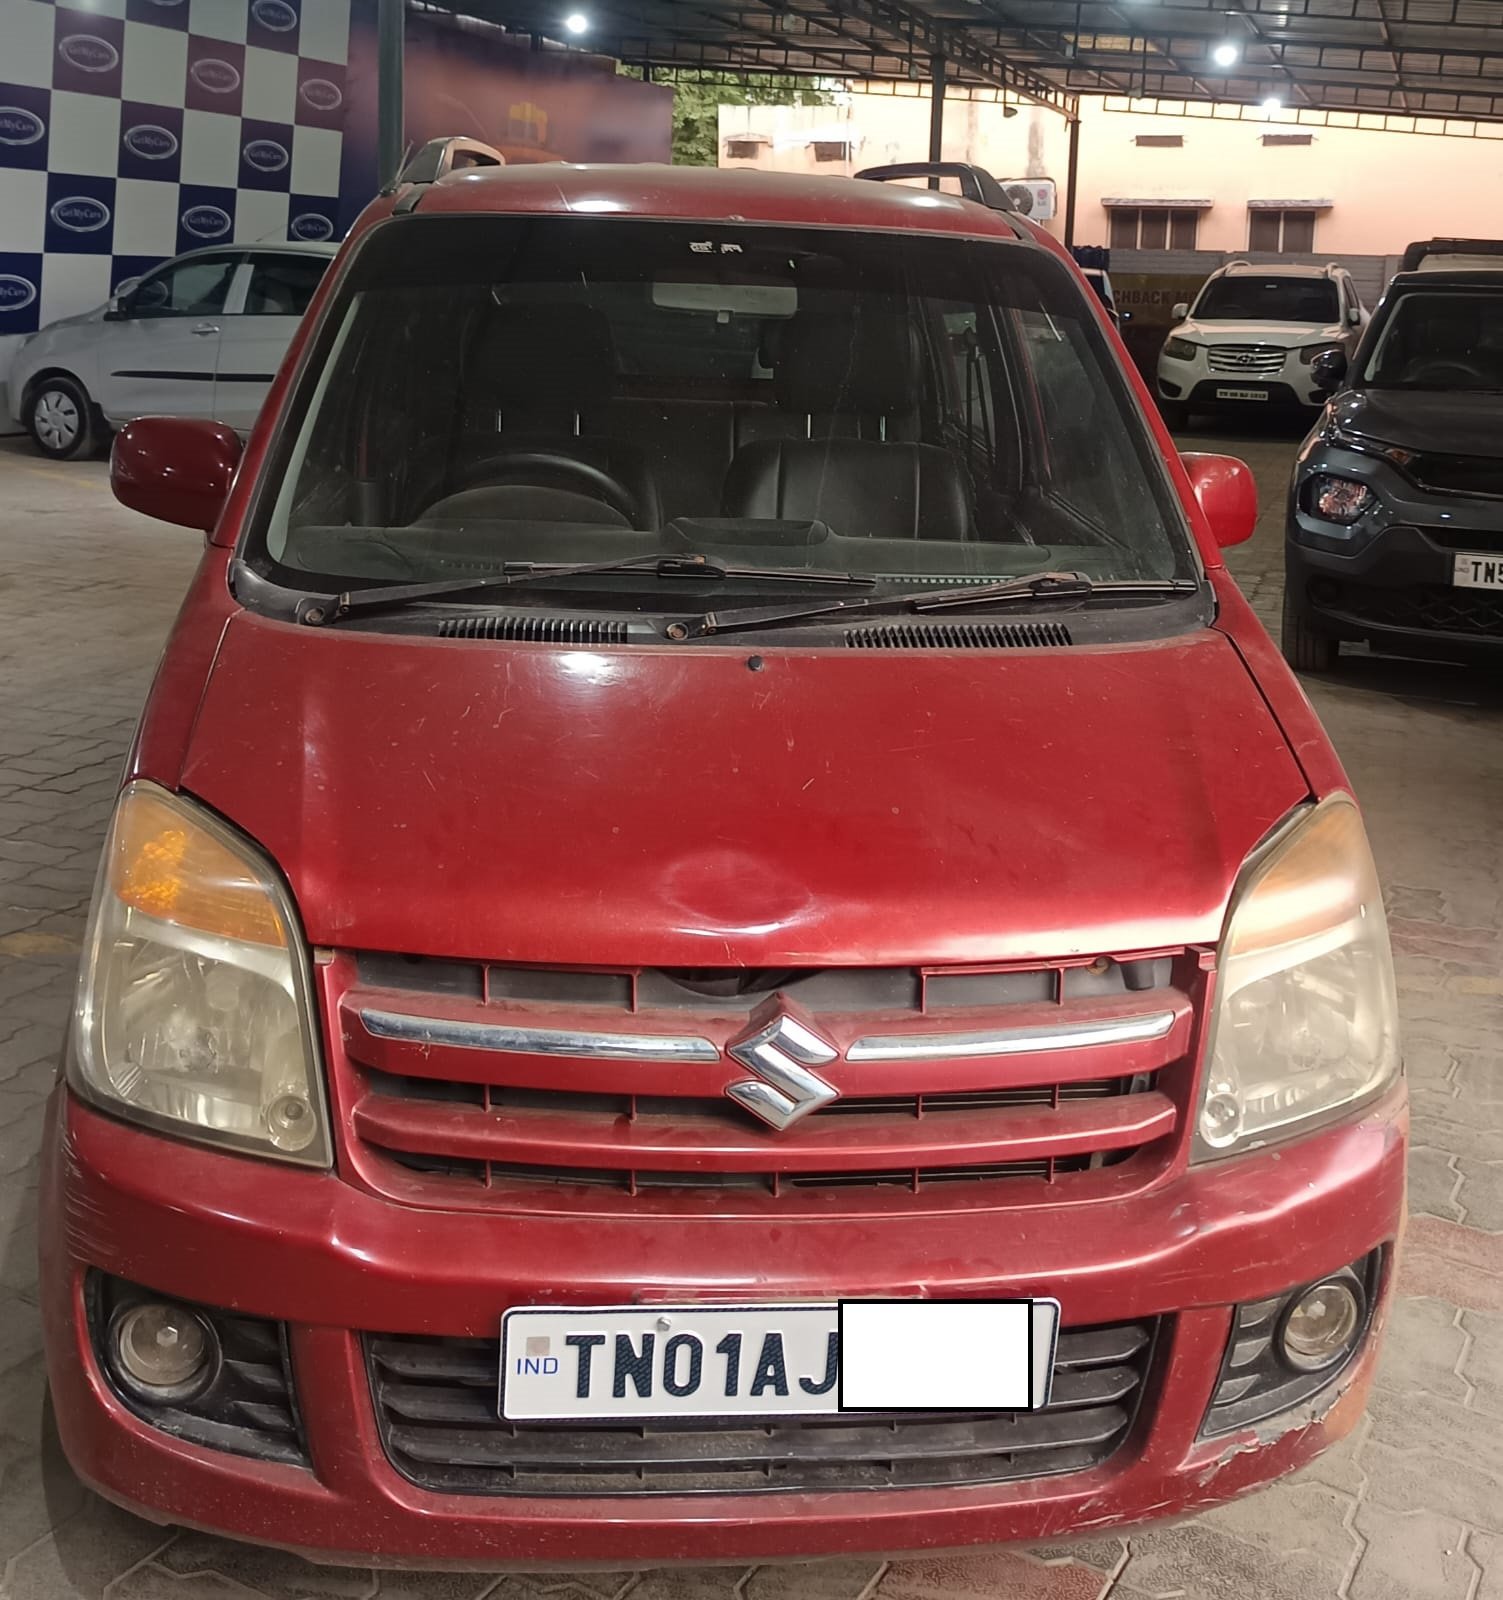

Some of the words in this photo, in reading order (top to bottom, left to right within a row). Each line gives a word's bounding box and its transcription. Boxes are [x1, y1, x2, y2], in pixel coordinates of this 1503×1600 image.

[60, 207, 102, 221] GetMyCars
[516, 1357, 558, 1376] IND
[565, 1332, 839, 1399] TN01AJ
